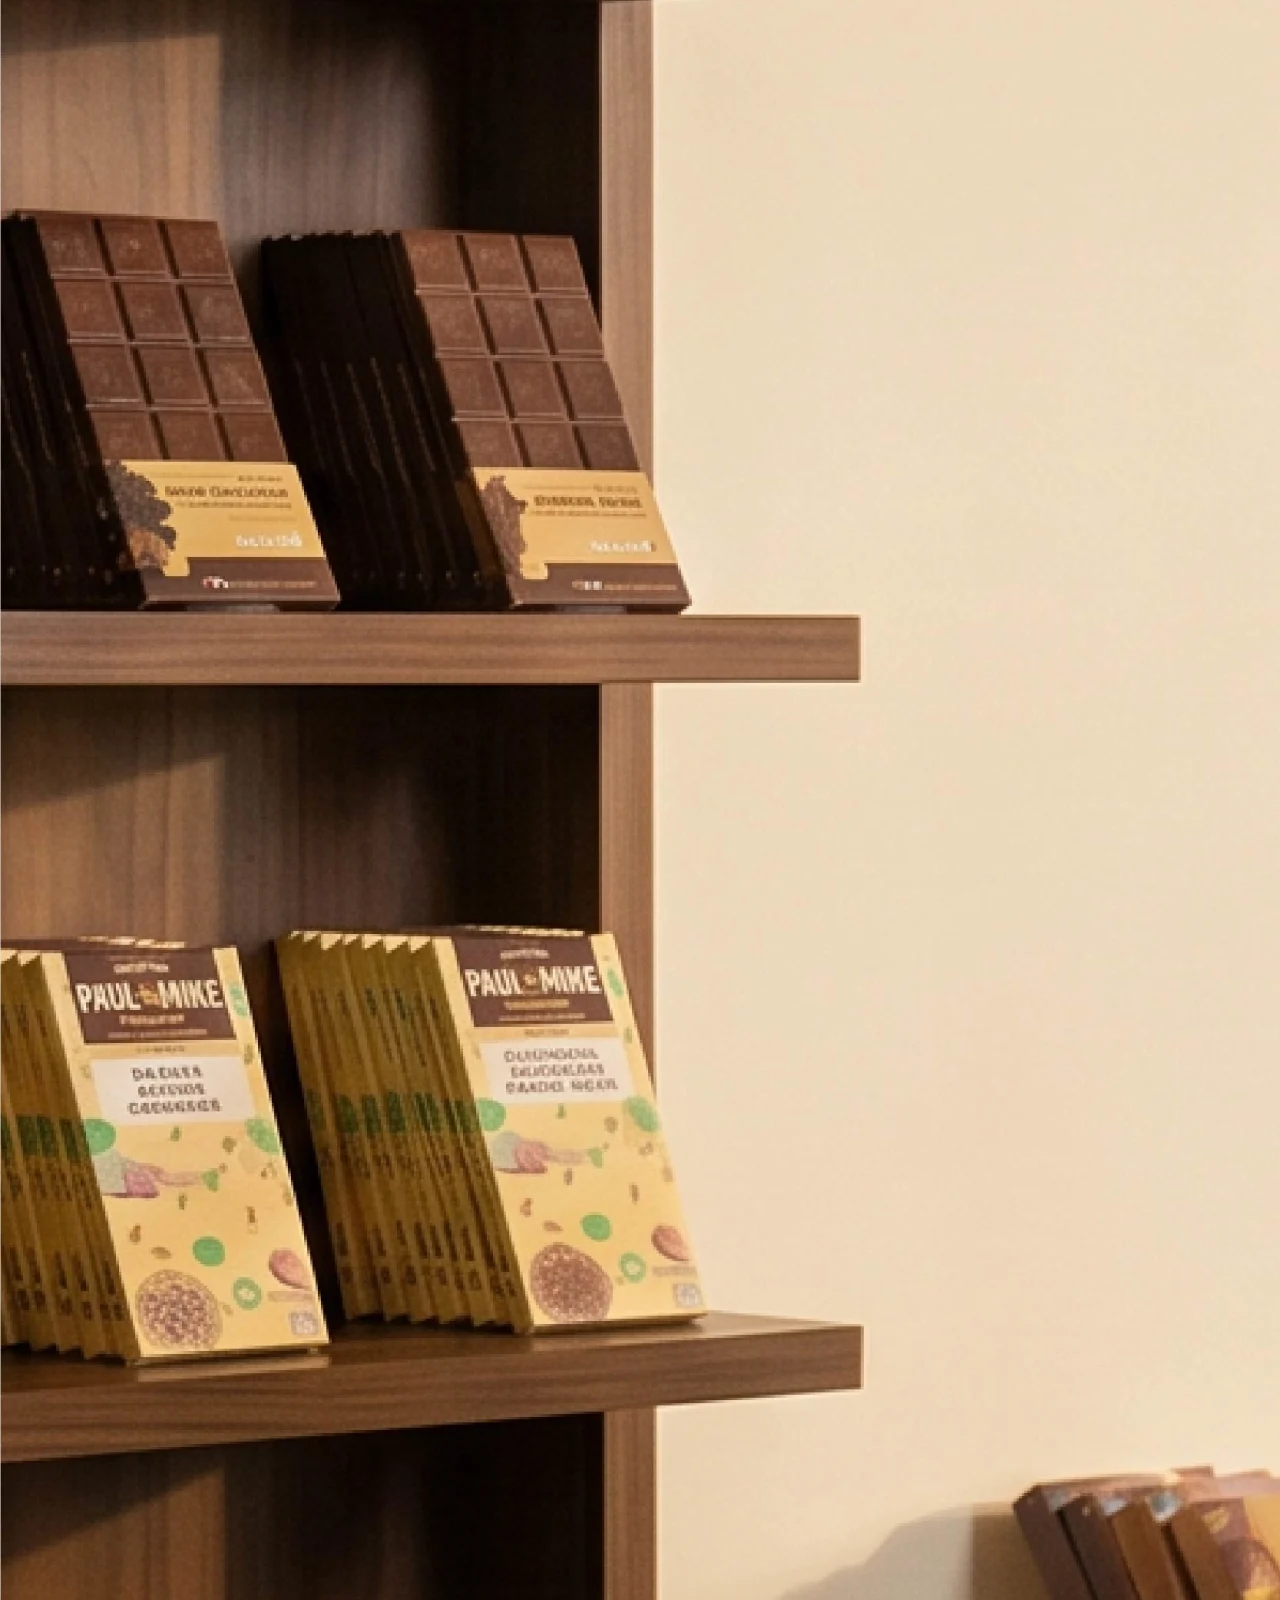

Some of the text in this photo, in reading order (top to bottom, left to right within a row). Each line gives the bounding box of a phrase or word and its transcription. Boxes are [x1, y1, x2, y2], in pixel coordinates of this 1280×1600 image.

[74, 978, 225, 1014] PAUL MIKE
[463, 968, 525, 997] PAUL
